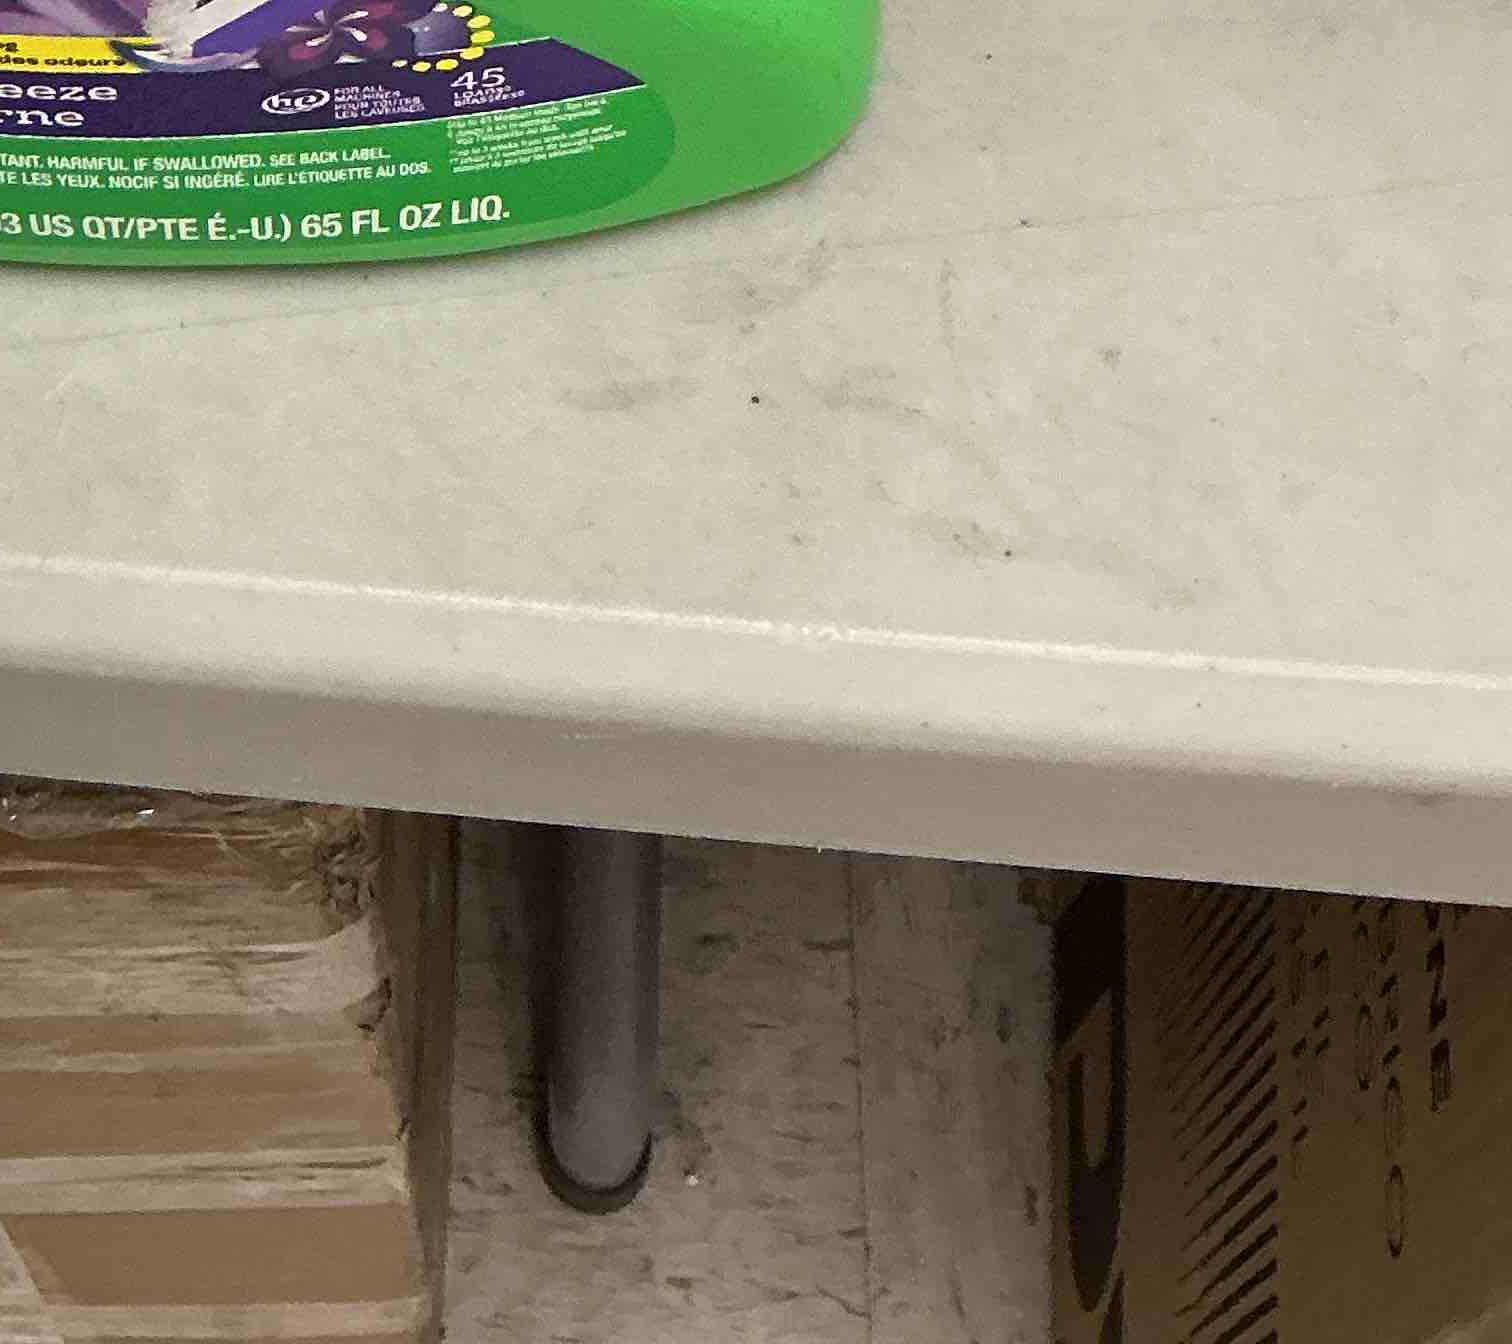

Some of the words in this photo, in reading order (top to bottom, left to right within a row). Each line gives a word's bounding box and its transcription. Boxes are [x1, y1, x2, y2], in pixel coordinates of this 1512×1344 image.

[44, 55, 127, 68] odeurs
[450, 66, 507, 91] 45
[47, 155, 130, 172] HARMFUL
[134, 156, 150, 172] IF
[153, 153, 266, 171] SWALLOWED.
[269, 153, 296, 168] SEE
[299, 149, 339, 165] BACK
[342, 145, 392, 162] LABEL.
[21, 171, 54, 188] LES
[56, 173, 106, 189] YEUX.
[108, 174, 159, 190] NOCIF
[162, 174, 180, 190] SI
[254, 171, 285, 189] LIRE
[375, 164, 396, 180] AU
[399, 162, 432, 177] DOS.
[29, 213, 74, 238] US
[81, 214, 200, 241] QT/PTE
[207, 211, 292, 242] É.-U.)
[300, 213, 343, 239] 65
[351, 208, 390, 236] FL
[398, 201, 442, 232] OZ
[450, 194, 511, 226] LIQ.
